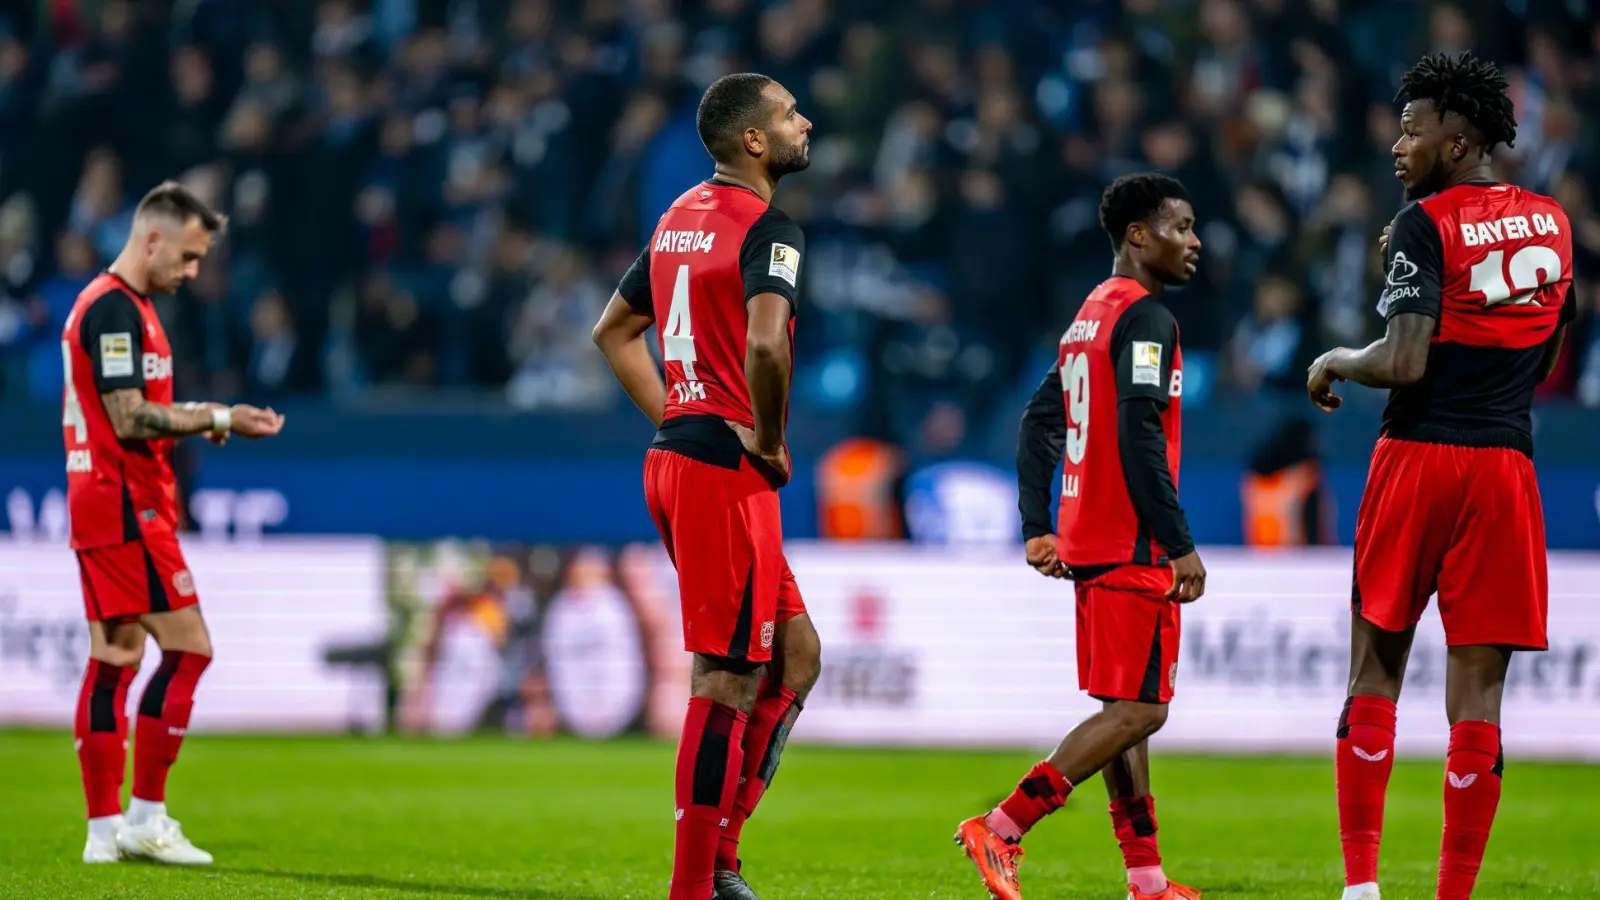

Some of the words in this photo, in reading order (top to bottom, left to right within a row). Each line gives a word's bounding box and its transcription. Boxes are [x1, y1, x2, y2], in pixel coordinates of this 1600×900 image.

[654, 230, 695, 253] BAYER
[692, 230, 716, 253] 04
[1460, 216, 1534, 247] BAYER
[1532, 213, 1560, 236] 04
[662, 265, 698, 381] 4
[674, 380, 707, 404] TAH
[1060, 351, 1090, 465] 19
